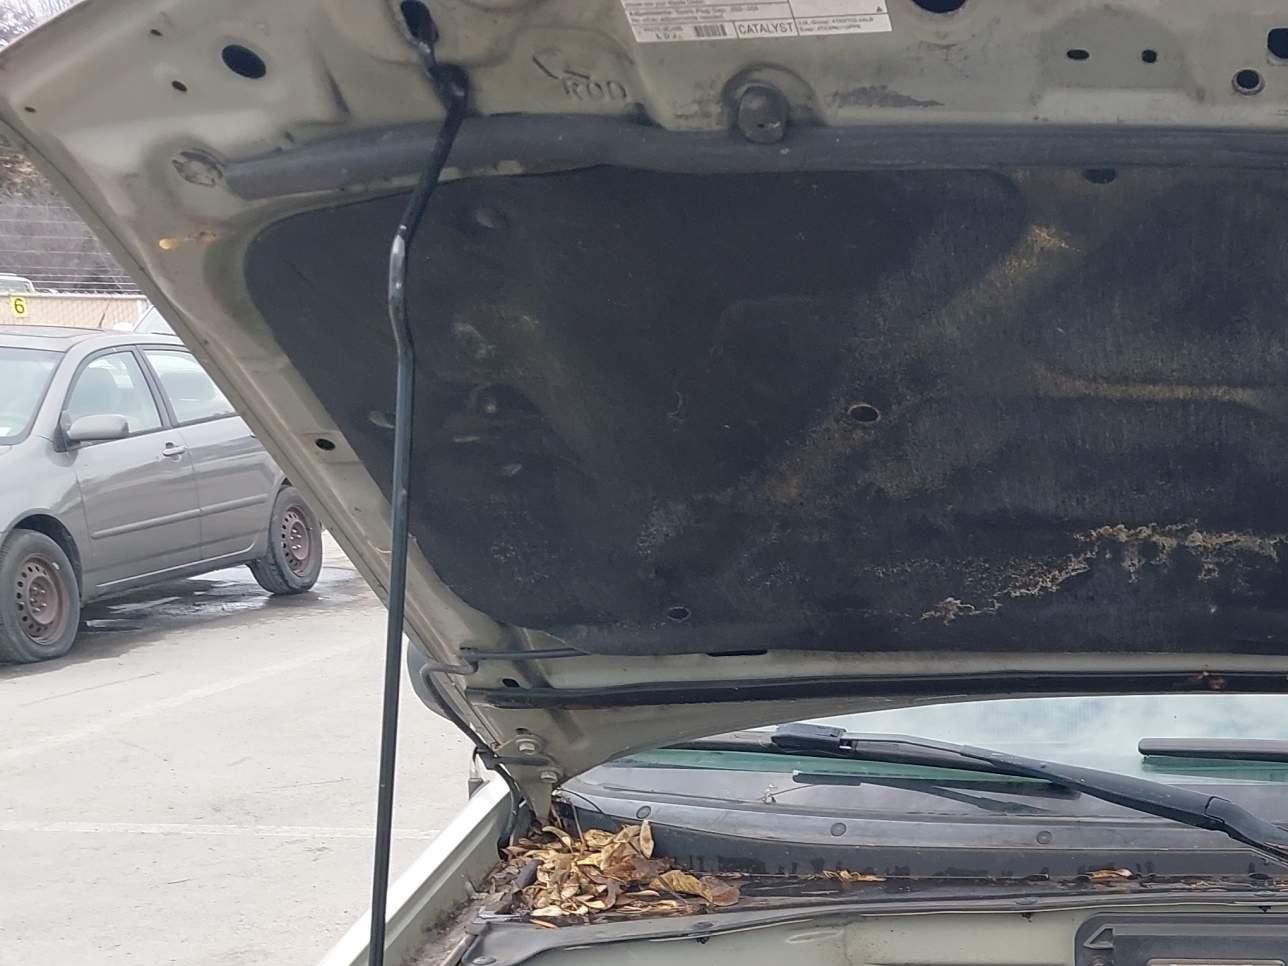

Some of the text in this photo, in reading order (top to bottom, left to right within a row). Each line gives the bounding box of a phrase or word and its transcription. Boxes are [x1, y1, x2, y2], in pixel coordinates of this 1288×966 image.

[738, 22, 794, 35] CATALYST
[562, 78, 627, 101] ROD
[14, 297, 25, 314] 6
